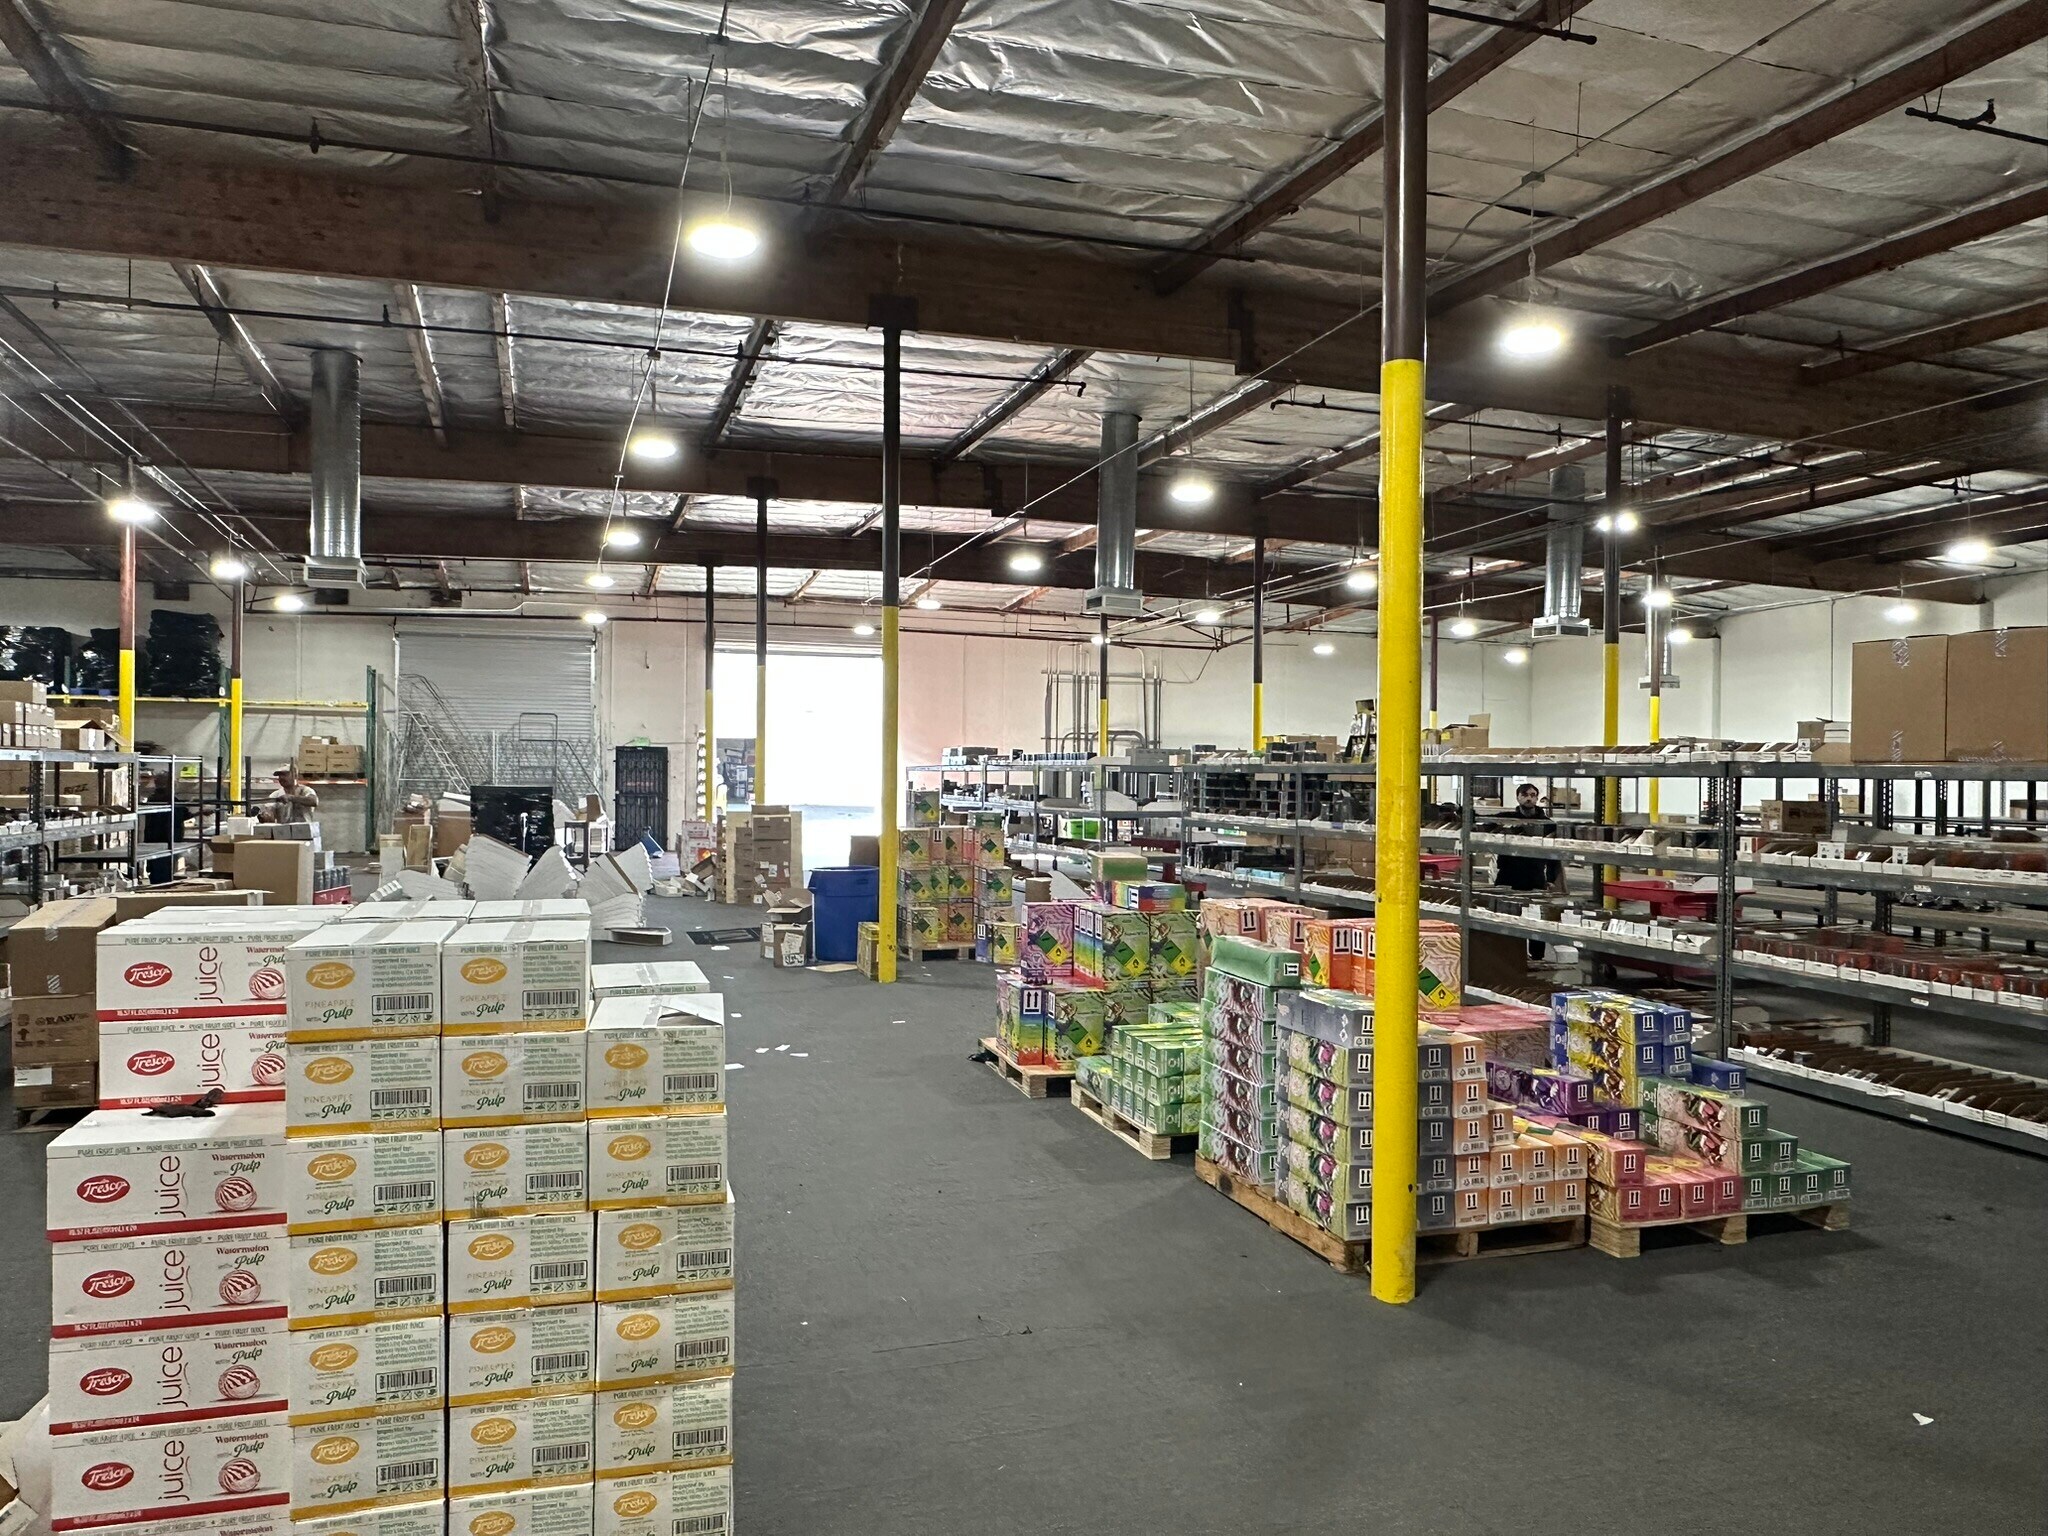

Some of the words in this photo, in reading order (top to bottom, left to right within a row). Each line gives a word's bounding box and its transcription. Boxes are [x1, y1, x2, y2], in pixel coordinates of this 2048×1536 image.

[194, 946, 224, 1004] juice
[322, 1006, 353, 1023] Pulp
[476, 1001, 505, 1017] Pulp
[45, 1014, 77, 1026] RAW
[197, 1032, 227, 1091] juice
[477, 1094, 505, 1110] Pulp
[619, 1086, 646, 1101] Pulp
[321, 1101, 351, 1118] Pulp
[230, 1159, 262, 1176] Pulp
[154, 1154, 187, 1219] juice
[479, 1185, 507, 1202] Pulp
[622, 1177, 649, 1193] Pulp
[324, 1197, 355, 1215] Pulp
[234, 1253, 265, 1269] Pulp
[159, 1248, 192, 1313] juice
[632, 1265, 660, 1281] Pulp
[483, 1276, 512, 1294] Pulp
[325, 1291, 355, 1309] Pulp
[232, 1347, 264, 1364] Pulp
[631, 1355, 658, 1372] Pulp
[156, 1345, 189, 1410] juice
[485, 1369, 513, 1386] Pulp
[326, 1387, 356, 1405] Pulp
[234, 1440, 264, 1457] Pulp
[628, 1444, 655, 1460] Pulp
[158, 1438, 191, 1504] juice
[487, 1460, 514, 1476] Pulp
[328, 1479, 357, 1497] Pulp
